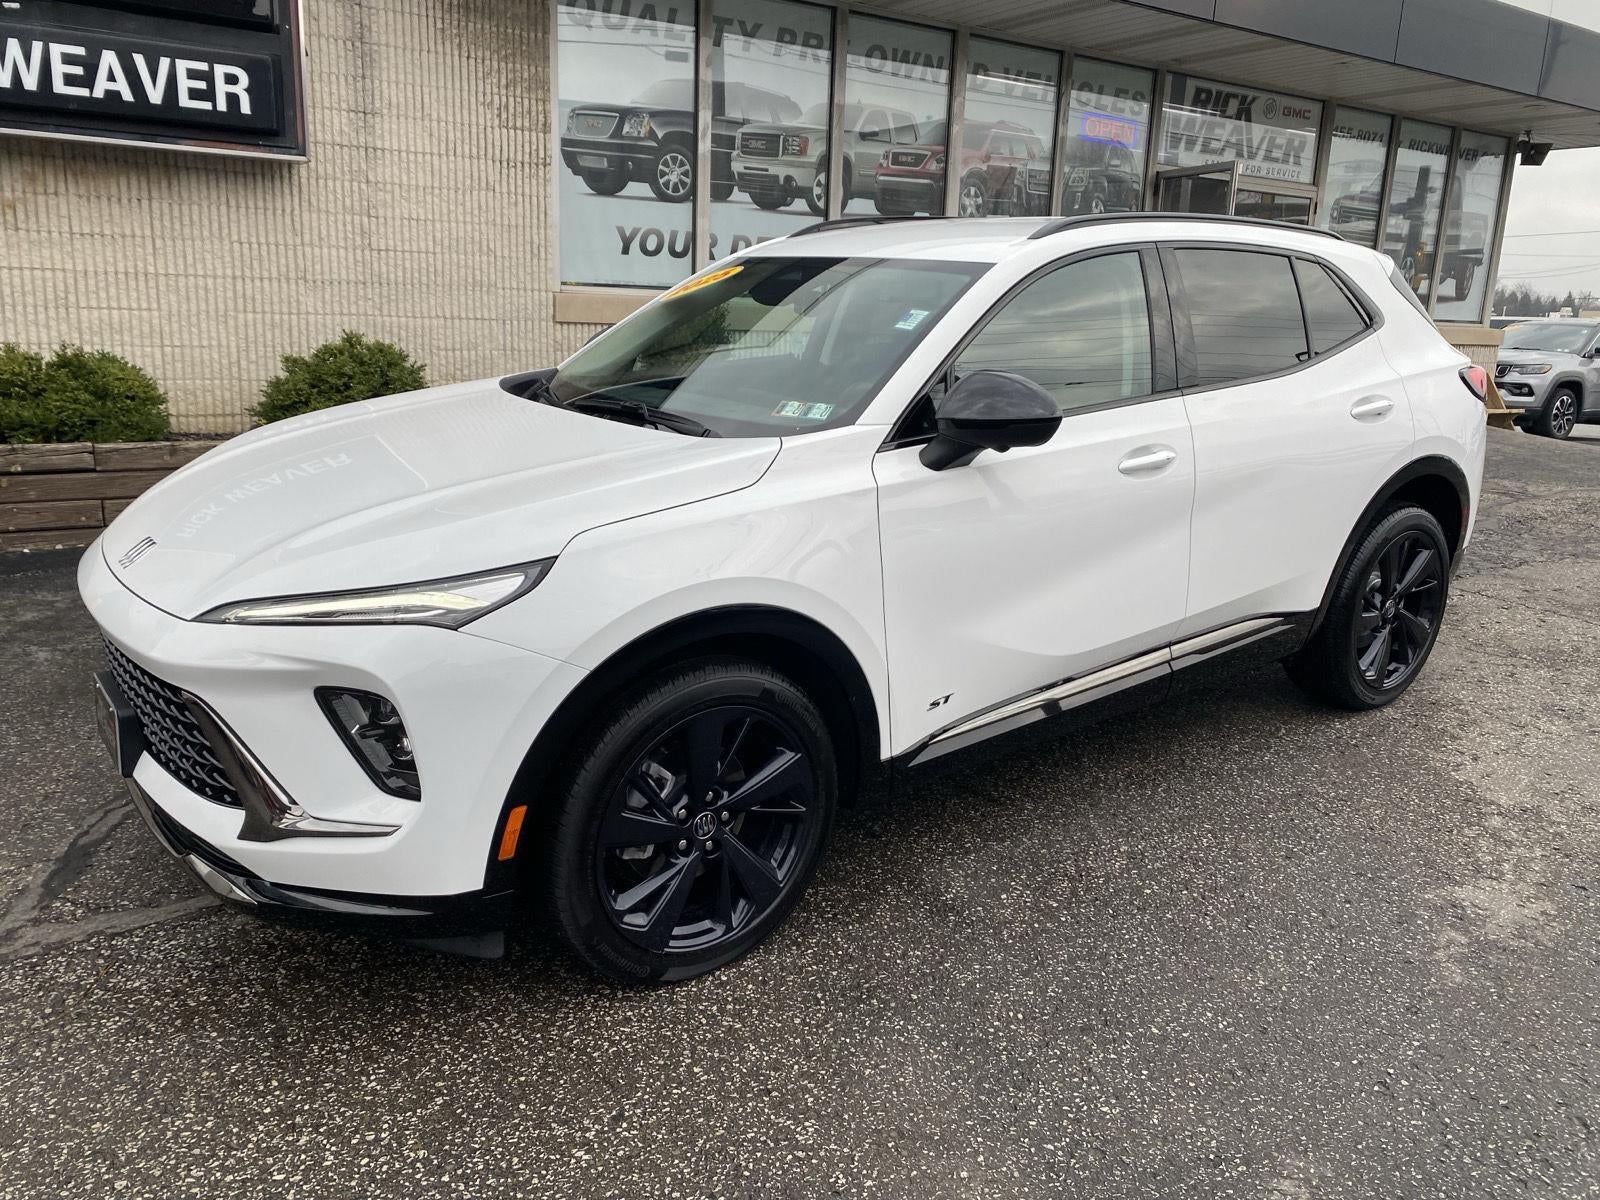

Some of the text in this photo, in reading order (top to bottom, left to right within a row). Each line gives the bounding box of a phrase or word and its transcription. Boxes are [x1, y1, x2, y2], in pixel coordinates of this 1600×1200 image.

[566, 0, 763, 53] QUALTY
[0, 37, 252, 115] WEAVER
[1190, 87, 1259, 122] RICK
[1282, 105, 1311, 120] GMC
[1085, 117, 1135, 143] OPEN
[1169, 113, 1307, 166] WEAVER
[1245, 164, 1302, 179] FOR SERVICE
[615, 225, 719, 261] YOUR
[926, 692, 955, 712] ST
